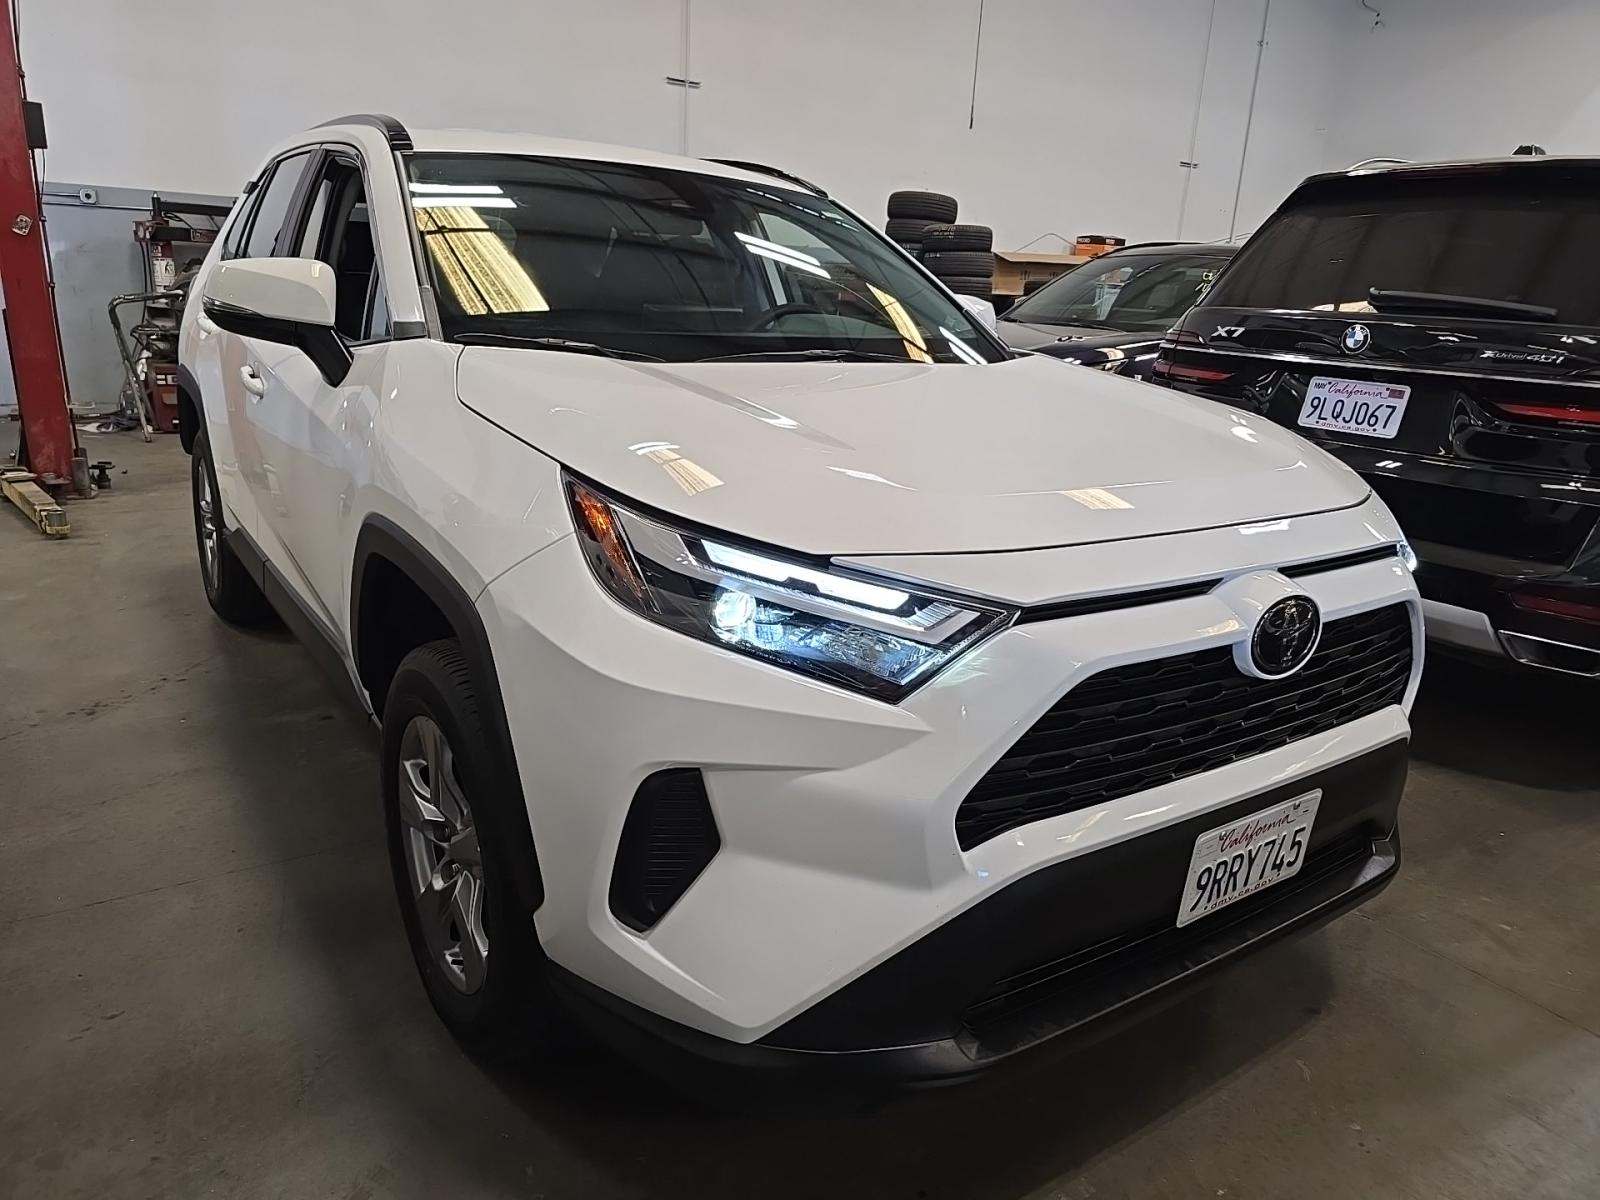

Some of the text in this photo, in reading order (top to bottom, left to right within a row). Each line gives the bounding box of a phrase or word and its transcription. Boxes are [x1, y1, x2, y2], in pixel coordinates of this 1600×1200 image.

[1211, 325, 1246, 338] X7
[1328, 381, 1388, 399] California
[1306, 396, 1398, 430] 9LQJ067
[1219, 813, 1297, 854] California
[1190, 826, 1307, 913] 9RRY745
